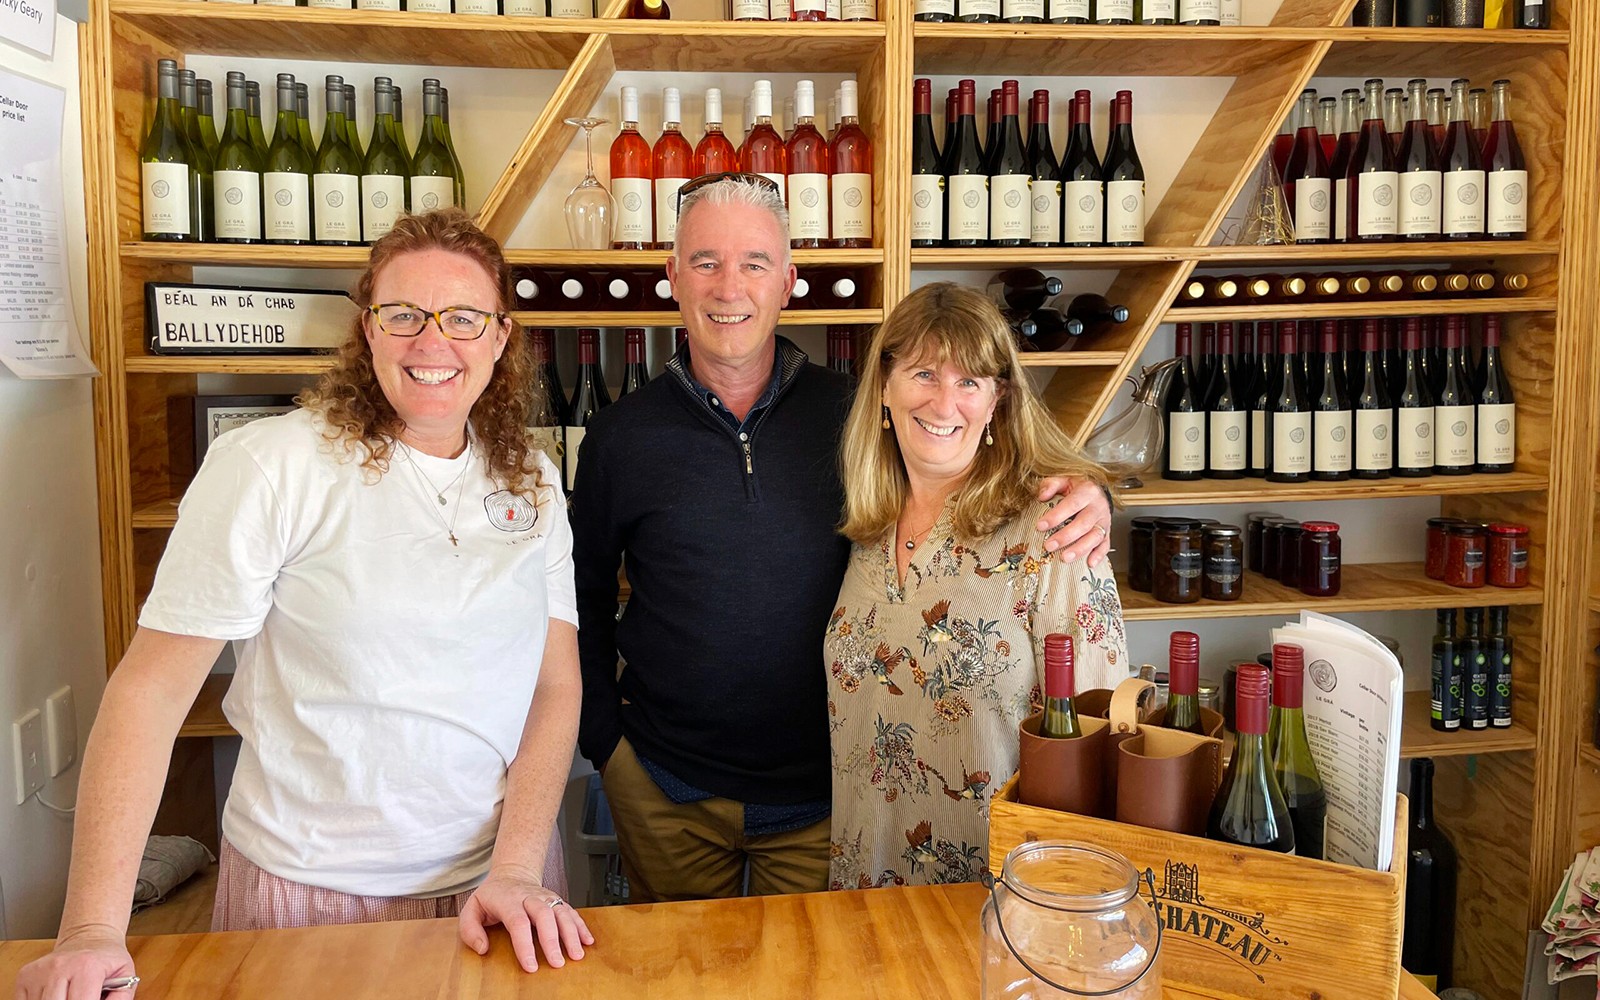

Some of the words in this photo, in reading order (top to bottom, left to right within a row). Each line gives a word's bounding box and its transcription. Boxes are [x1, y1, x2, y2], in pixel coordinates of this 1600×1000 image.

[0, 0, 18, 13] icky
[20, 1, 43, 24] Geary
[15, 100, 28, 111] Door
[2, 110, 15, 121] price
[17, 112, 25, 122] list
[165, 290, 198, 306] BÉAL
[211, 296, 227, 307] AN
[238, 294, 254, 308] DÁ
[265, 297, 296, 310] CHAB
[165, 322, 286, 344] BALLYDEHOB
[1340, 708, 1355, 718] Vintage
